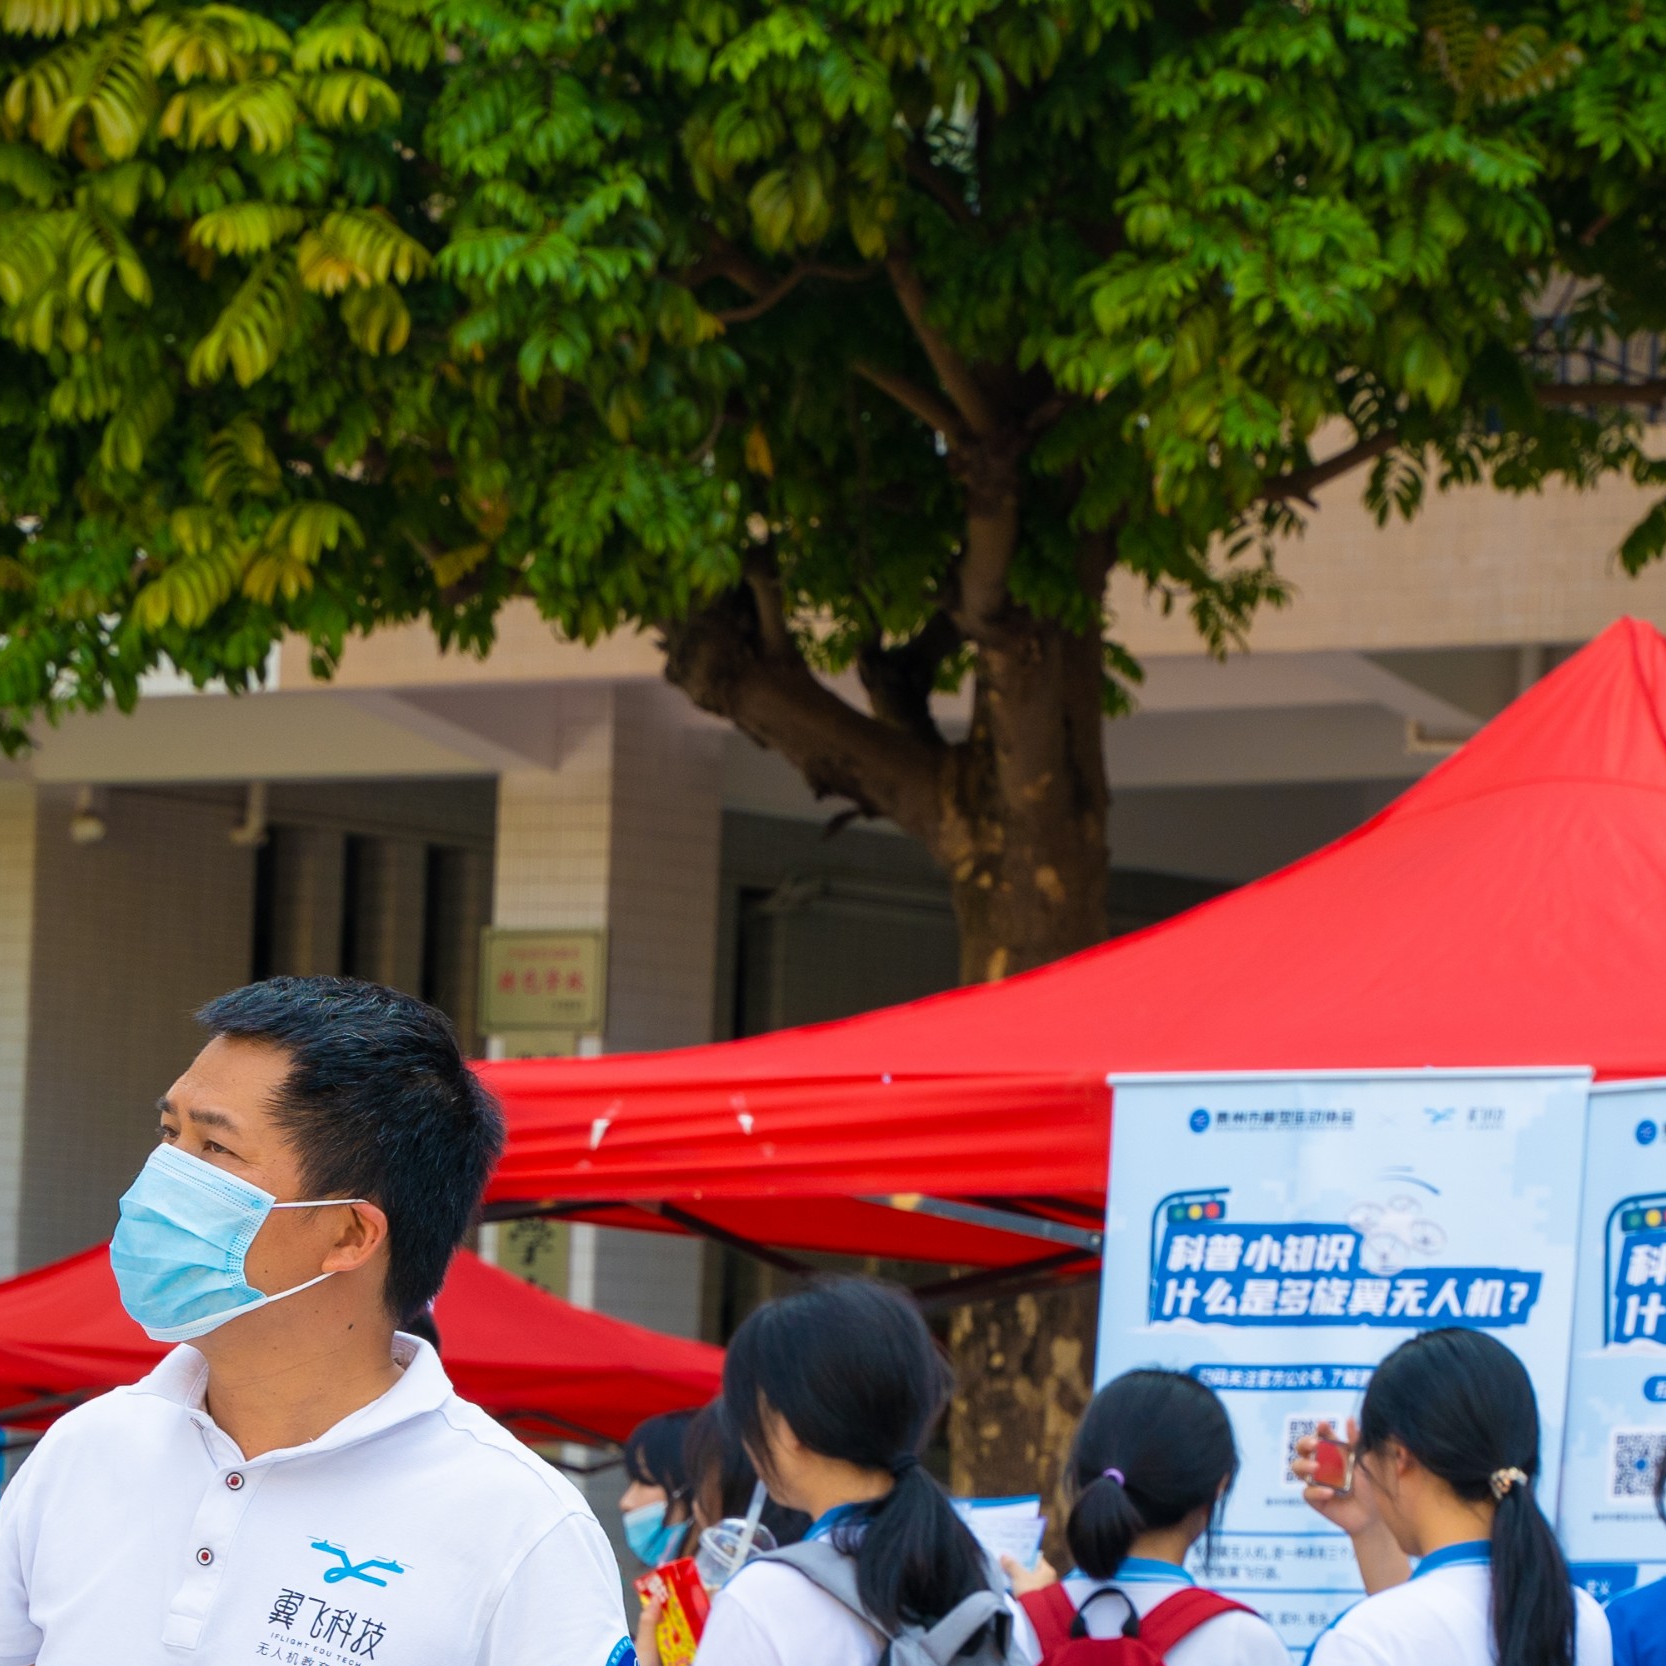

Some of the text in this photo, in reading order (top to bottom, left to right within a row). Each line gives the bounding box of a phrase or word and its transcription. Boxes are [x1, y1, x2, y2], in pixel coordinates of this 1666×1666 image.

[1166, 1233, 1356, 1273] 科普小知识
[268, 1588, 387, 1660] 翼飞科技
[270, 1632, 310, 1649] IFLIGHT
[312, 1646, 332, 1657] EDU
